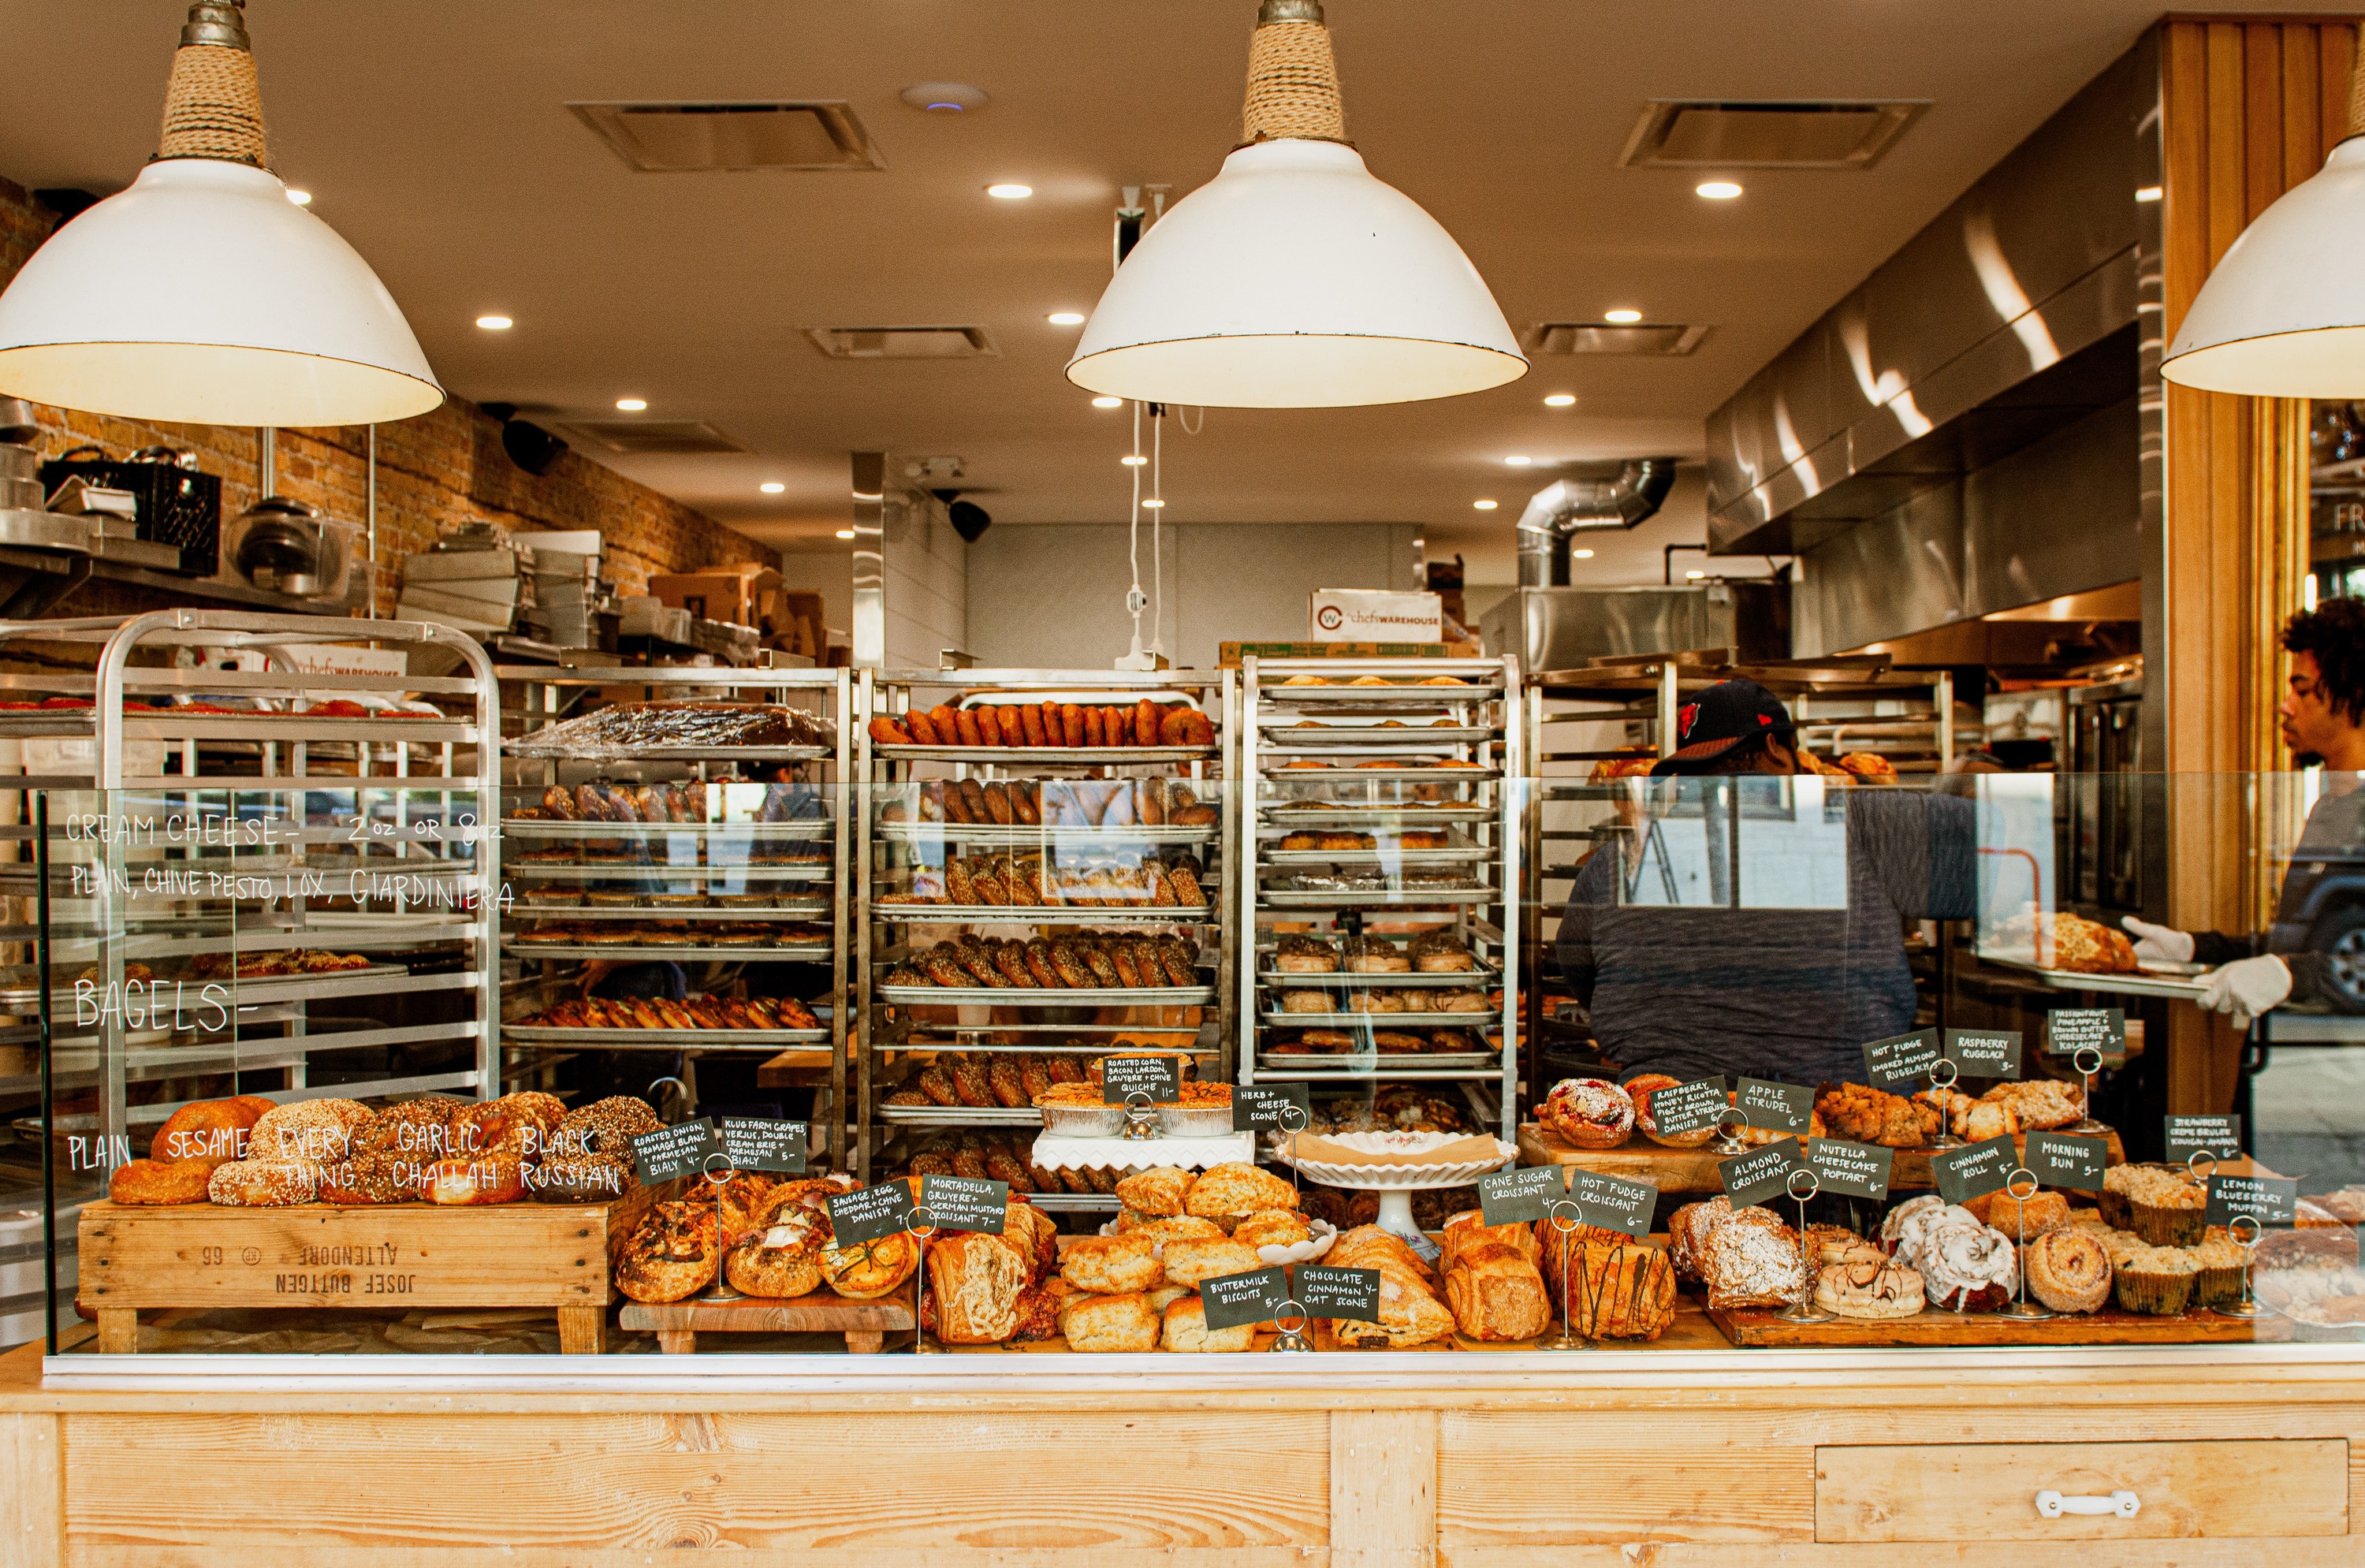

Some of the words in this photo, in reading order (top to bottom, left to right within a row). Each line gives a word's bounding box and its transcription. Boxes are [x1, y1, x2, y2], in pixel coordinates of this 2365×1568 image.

[65, 814, 154, 845] CREAM
[414, 819, 443, 840] OR
[71, 866, 138, 900] PLAIN,
[144, 867, 203, 896] CHIVE
[208, 871, 279, 906] PESTO,
[287, 872, 333, 904] LOX,
[350, 869, 515, 914] GIARDINIERA
[1872, 1045, 1890, 1057] HOT
[1894, 1039, 1922, 1052] FUDGE
[1958, 1037, 2009, 1050] RASPBERRY
[1872, 1060, 1903, 1072] SMOKED
[1905, 1050, 1936, 1064] ALMOND
[1963, 1050, 2004, 1059] RUGELACH
[1136, 1066, 1167, 1075] LARDON,
[1886, 1062, 1929, 1081] RUGELACH
[1655, 1097, 1682, 1108] HONEY
[1687, 1089, 1722, 1102] RICOTTA,
[1657, 1082, 1708, 1100] RASPBERRY,
[1749, 1085, 1785, 1100] APPLE
[1257, 1100, 1290, 1108] CHEESE
[1657, 1107, 1675, 1116] FIGS
[1685, 1100, 1714, 1111] BROWN
[1745, 1097, 1792, 1114] STRUDEL
[1250, 1112, 1278, 1121] SCONE
[1665, 1111, 1693, 1124] BUTTER
[1695, 1102, 1729, 1115] STREUSEL
[725, 1120, 747, 1129] KLUG
[749, 1121, 772, 1130] FARM
[774, 1123, 806, 1136] GRAPES,
[1664, 1118, 1698, 1133] DANISH
[166, 1126, 249, 1159] SESAME
[398, 1121, 482, 1154] GARLIC
[519, 1126, 594, 1156] BLACK
[635, 1130, 670, 1146] ROASTED
[673, 1123, 705, 1137] ONION,
[762, 1131, 793, 1140] DOUBLE
[68, 1134, 132, 1171] PLAIN
[638, 1140, 676, 1156] FROMAGE
[678, 1133, 706, 1146] BLANC
[727, 1140, 754, 1149] CREAM
[729, 1148, 772, 1157] PARMESAN
[1819, 1144, 1867, 1159] NUTELLA
[2042, 1142, 2089, 1158] MORNING
[652, 1145, 698, 1162] PARMESAN
[732, 1155, 759, 1166] BIALY
[1949, 1147, 1999, 1171] CINNAMON
[650, 1160, 678, 1175] BIALY
[1735, 1153, 1781, 1177] ALMOND
[1813, 1156, 1879, 1172] CHEESECAKE
[2050, 1156, 2073, 1169] BUN
[281, 1163, 355, 1188] THING
[393, 1160, 497, 1189] CHALLAH
[520, 1162, 620, 1195] RUSSIAN
[1484, 1175, 1513, 1189] CANE
[1518, 1170, 1554, 1183] SUGAR
[1732, 1160, 1790, 1190] CROISSANT
[1963, 1166, 1987, 1179] ROLL
[874, 1185, 896, 1196] EGG,
[931, 1178, 994, 1196] MORTADELLA,
[1492, 1184, 1546, 1200] CROISSANT
[1581, 1176, 1604, 1191] HOT
[1610, 1183, 1646, 1201] FUDGE
[2222, 1179, 2264, 1191] LEMON
[928, 1190, 971, 1202] GRUYERE
[1581, 1190, 1639, 1212] CROISSANT
[2215, 1190, 2282, 1205] BLUEBERRY
[851, 1206, 890, 1223] DANISH
[930, 1201, 968, 1212] GERMAN
[970, 1205, 1004, 1215] MUSTARD
[2228, 1203, 2267, 1214] MUFFIN
[929, 1212, 978, 1223] CROISSANT
[298, 1245, 398, 1266] ALTENDORF
[365, 1274, 416, 1294] JOSEF
[1210, 1275, 1269, 1294] BUTTERMILK
[1304, 1270, 1363, 1285] CHOCOLATE
[1222, 1289, 1261, 1305] BISCUITS
[1308, 1284, 1361, 1296] CINNAMON
[1305, 1295, 1329, 1304] OAT
[1336, 1298, 1368, 1308] SCONE
